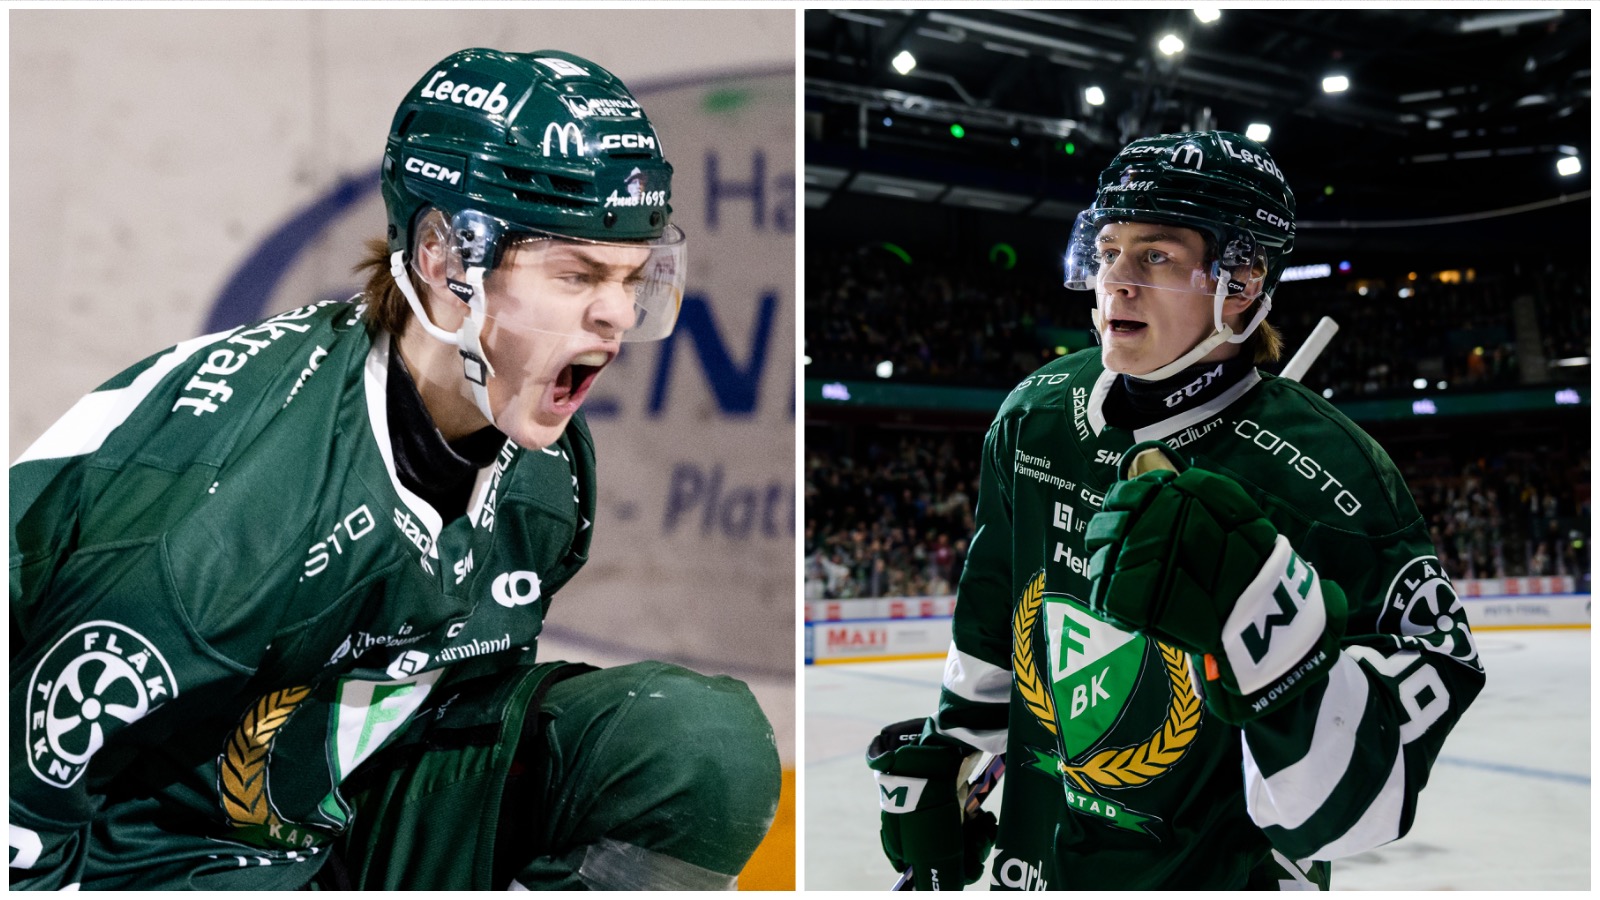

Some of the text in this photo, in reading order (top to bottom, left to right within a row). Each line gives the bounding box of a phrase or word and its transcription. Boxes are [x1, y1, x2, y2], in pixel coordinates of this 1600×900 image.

[421, 70, 508, 115] Lecab
[602, 134, 655, 149] CCM
[405, 157, 461, 186] CCM
[1223, 139, 1285, 183] Lecab
[640, 191, 665, 206] 1698
[1256, 208, 1290, 231] CCM
[449, 283, 473, 294] CCM
[1228, 280, 1244, 291] CCM
[172, 300, 336, 416] akraft
[1014, 373, 1070, 393] STO
[1163, 363, 1223, 408] CCM
[1073, 387, 1090, 441] stadium
[1166, 417, 1223, 451] adium
[1016, 450, 1051, 469] Thermia
[1232, 419, 1362, 516] CONSTO
[1014, 462, 1077, 492] Värmepumpar
[1080, 488, 1103, 508] CC
[299, 504, 376, 583] STO
[1059, 614, 1091, 673] F
[83, 632, 168, 700] FLÄK
[1070, 666, 1111, 720] BK
[1251, 695, 1270, 713] BK
[33, 679, 82, 781] TEKN
[899, 733, 921, 742] CC
[269, 823, 323, 848] KAR
